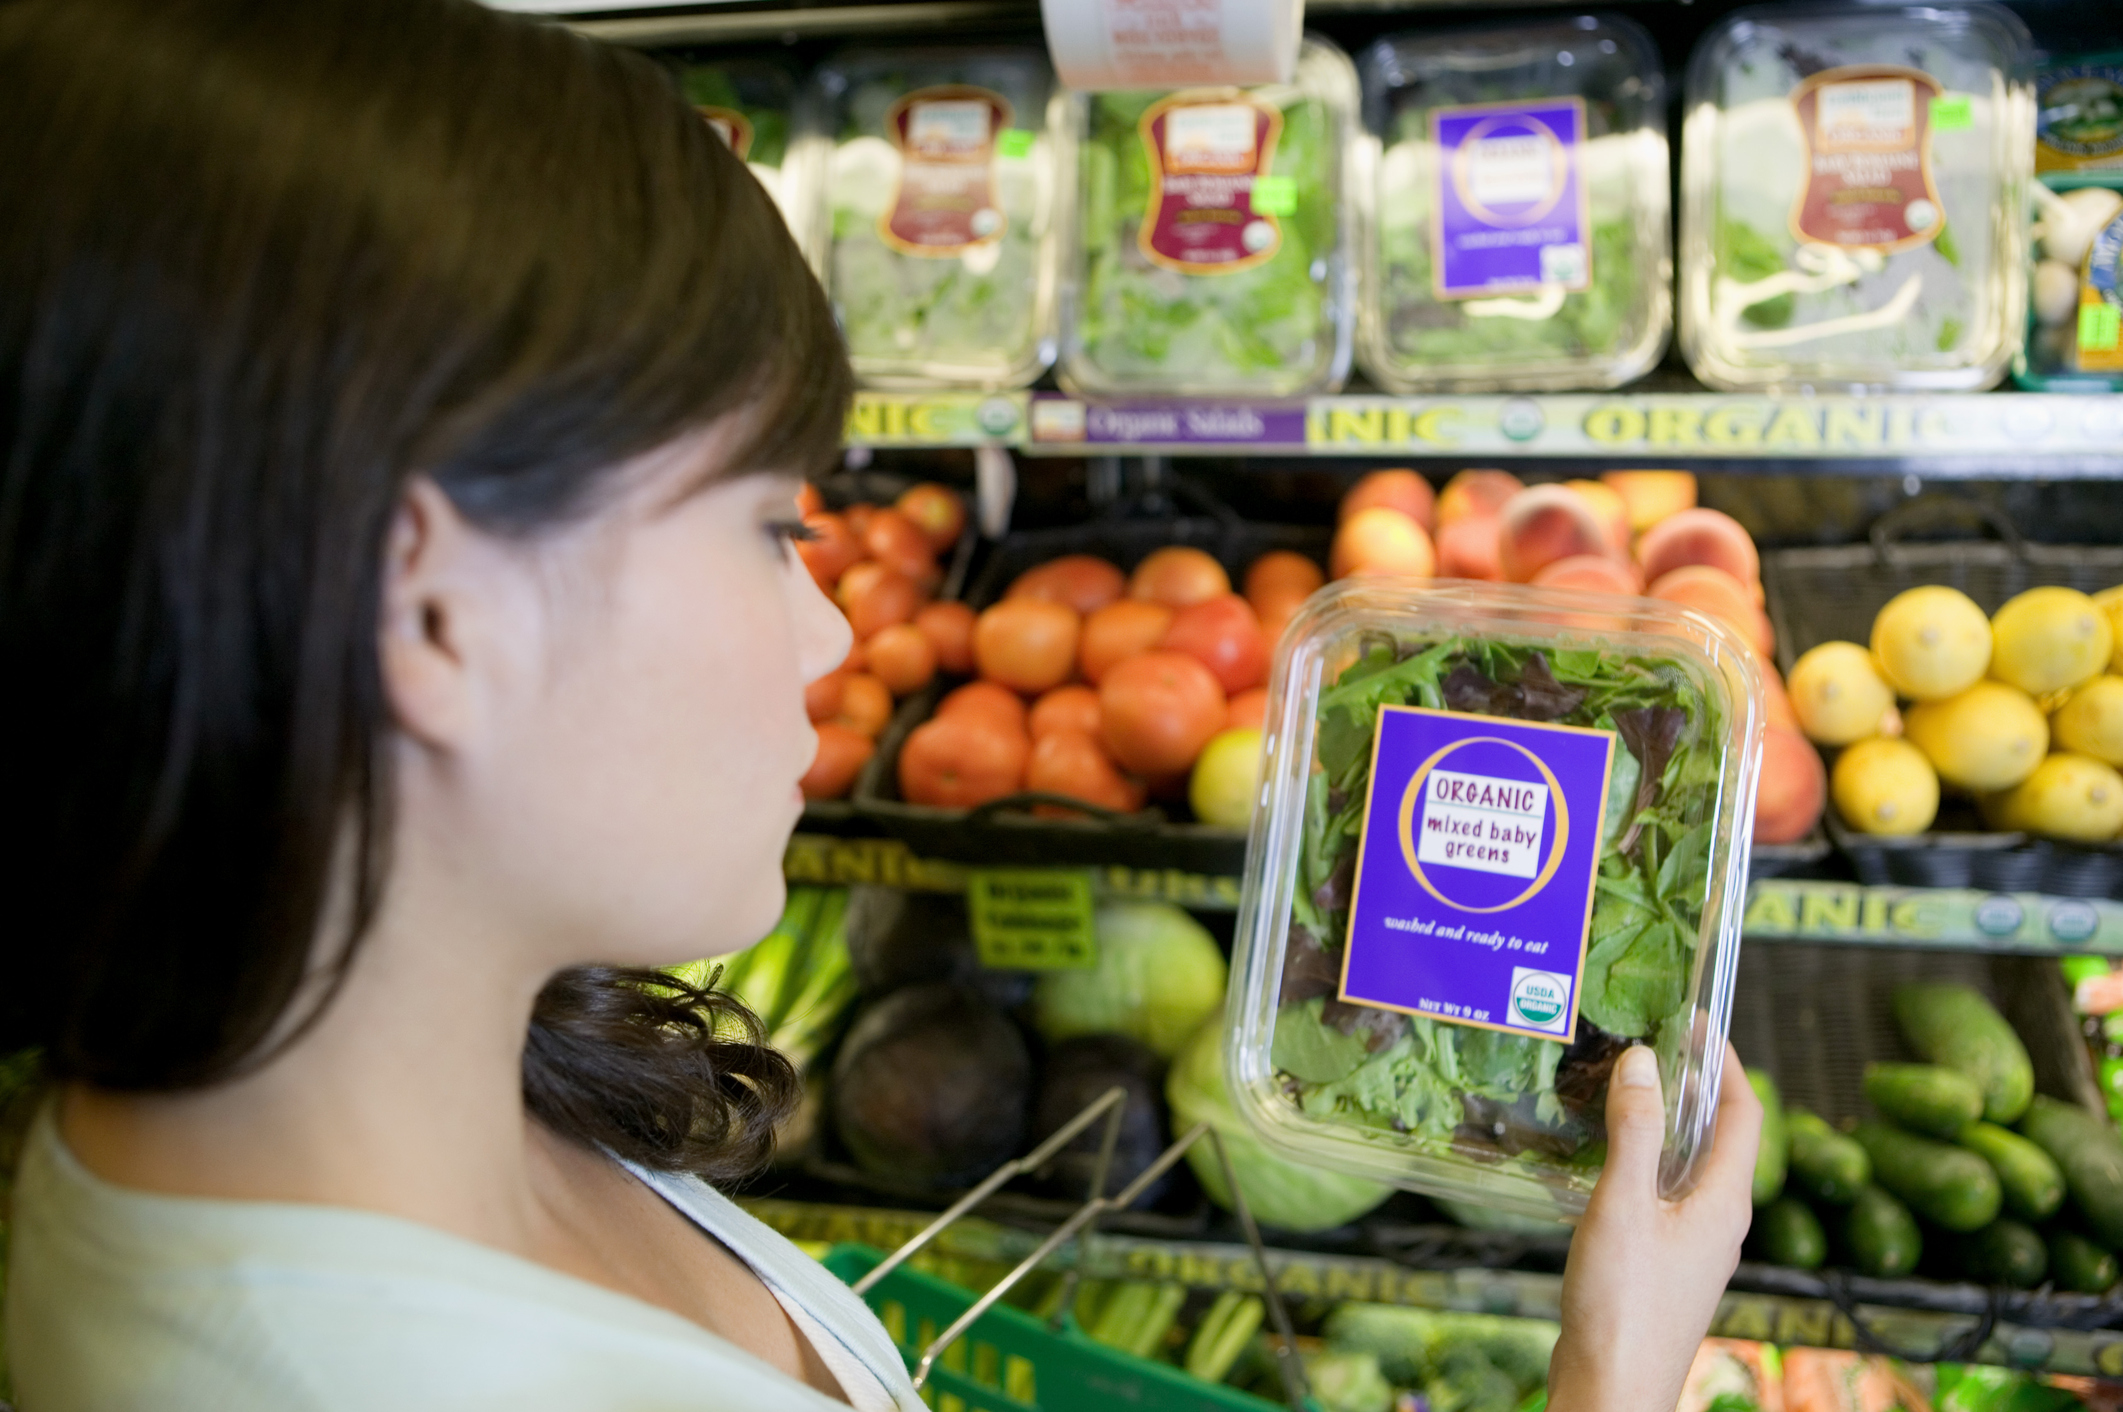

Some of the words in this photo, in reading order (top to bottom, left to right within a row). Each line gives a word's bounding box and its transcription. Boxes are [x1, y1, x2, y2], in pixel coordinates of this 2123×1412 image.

[1436, 778, 1533, 812] ORGANIC
[1427, 814, 1483, 838] mixed
[1490, 821, 1537, 849] baby
[1445, 841, 1509, 863] greens
[1384, 916, 1436, 936] washed
[1435, 925, 1466, 940] and
[1466, 930, 1505, 951] ready
[1507, 936, 1522, 950] to
[1524, 940, 1549, 955] eat
[1526, 985, 1554, 999] USDA
[1462, 1005, 1472, 1019] 9
[1519, 998, 1558, 1014] ORGANIC
